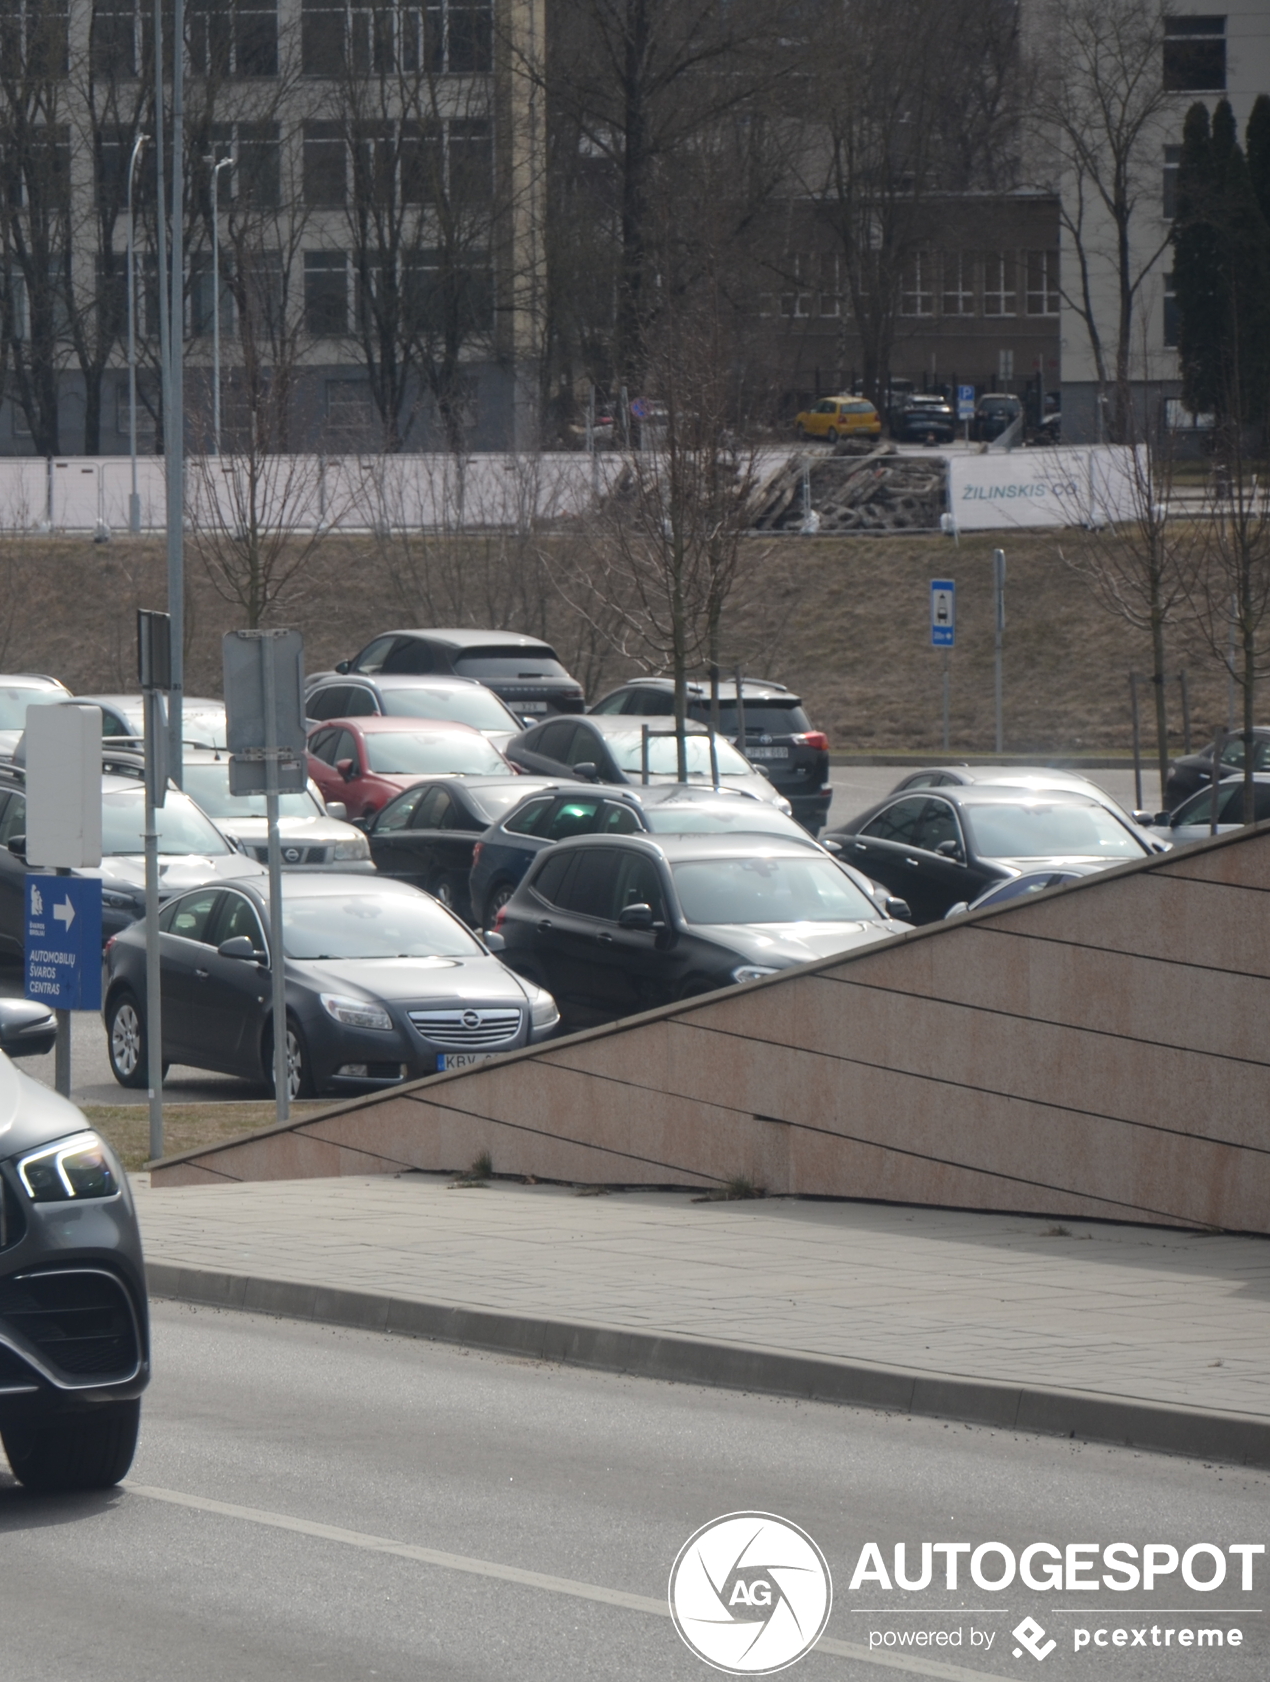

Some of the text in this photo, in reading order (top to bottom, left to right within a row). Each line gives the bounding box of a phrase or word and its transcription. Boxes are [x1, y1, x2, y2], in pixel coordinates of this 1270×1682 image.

[962, 483, 1046, 501] ŽILINSKIS
[30, 950, 76, 973] AUTOMOBILIŲ
[30, 963, 57, 979] ŠVAROS
[30, 981, 61, 995] CENTRAS
